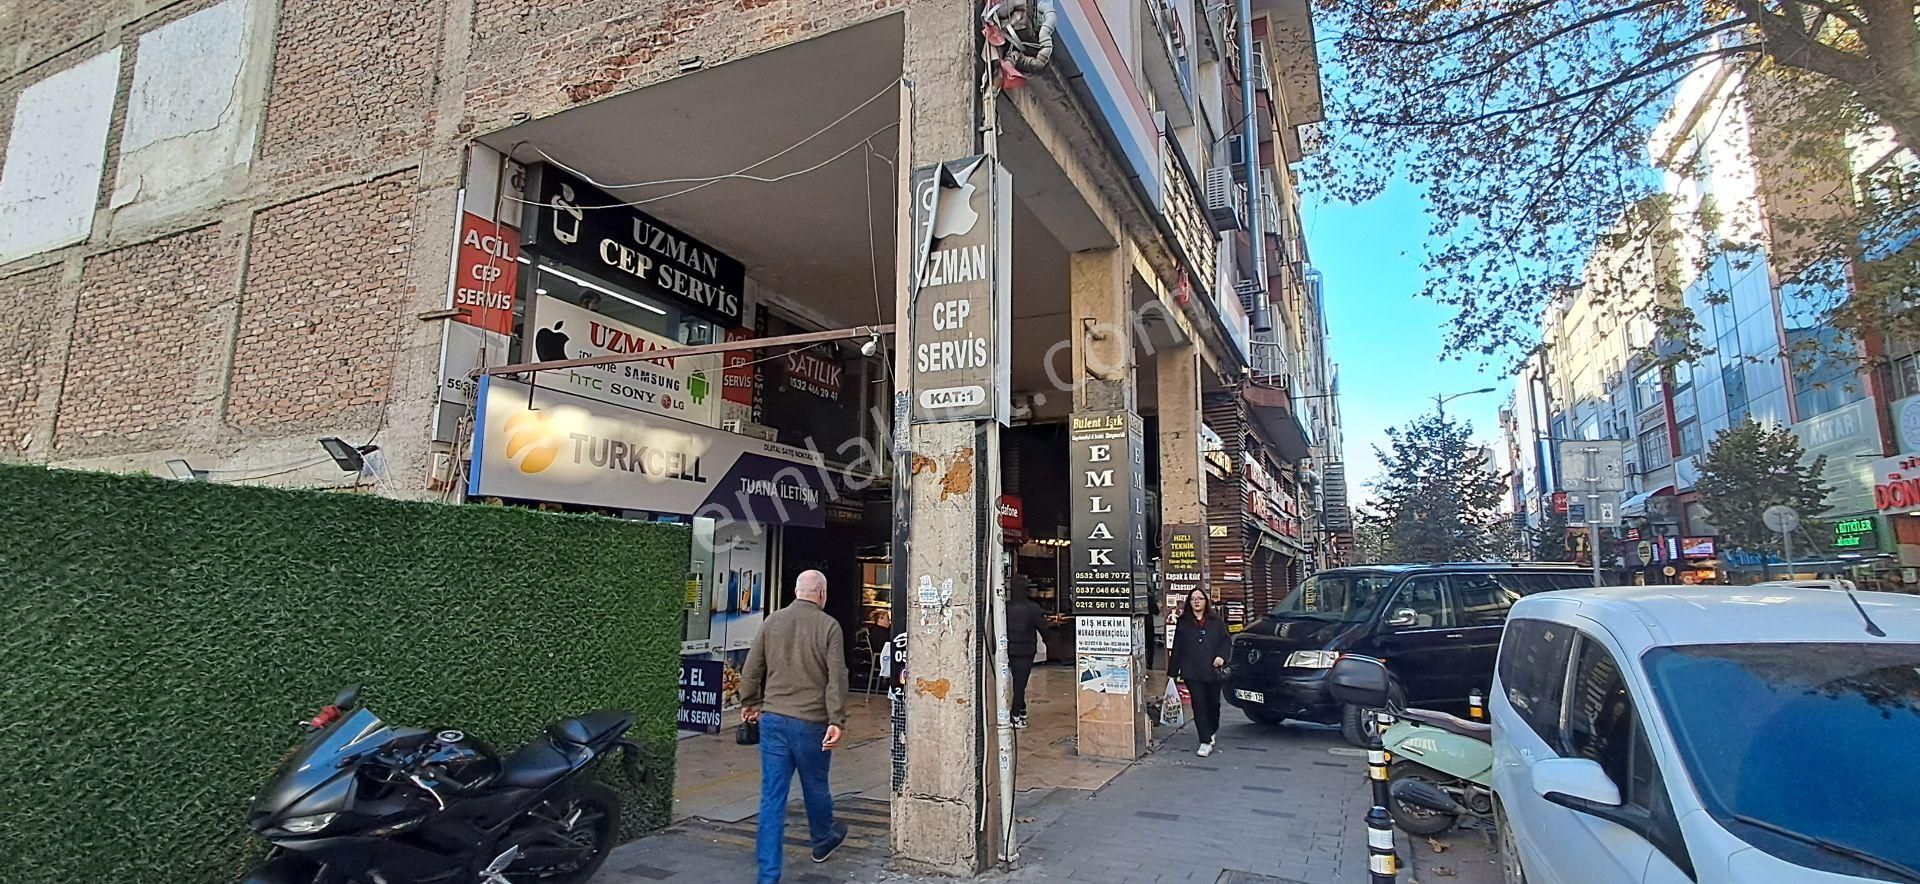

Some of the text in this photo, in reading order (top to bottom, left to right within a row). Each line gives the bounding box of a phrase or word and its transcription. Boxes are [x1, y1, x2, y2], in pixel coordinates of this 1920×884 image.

[464, 229, 514, 262] ACİL
[632, 216, 719, 279] UZMAN
[471, 264, 501, 282] CEP
[599, 238, 738, 317] CEP SERVİS
[457, 288, 511, 310] SERVİS
[932, 299, 970, 331] CEP
[589, 320, 676, 370] UZMAN
[917, 332, 987, 373] SERVİS
[624, 366, 680, 391] SAMSUNG
[787, 349, 842, 388] SATILIK
[724, 374, 752, 388] SERVİS
[610, 381, 656, 404] SONY
[673, 399, 685, 410] LG
[930, 389, 975, 405] KAT:1
[569, 432, 707, 483] TURKCELL
[740, 477, 778, 497] TUANA
[1084, 444, 1115, 566] EMLAK
[1133, 447, 1144, 566] EMLAK
[1171, 542, 1194, 550] TEKNİK
[1171, 550, 1195, 558] SERVİS
[1075, 601, 1093, 609] 0212
[1081, 618, 1125, 628] DİŞ HEKİMİ
[690, 667, 705, 687] EL
[691, 690, 717, 706] SATIM
[690, 709, 721, 726] SERVİS
